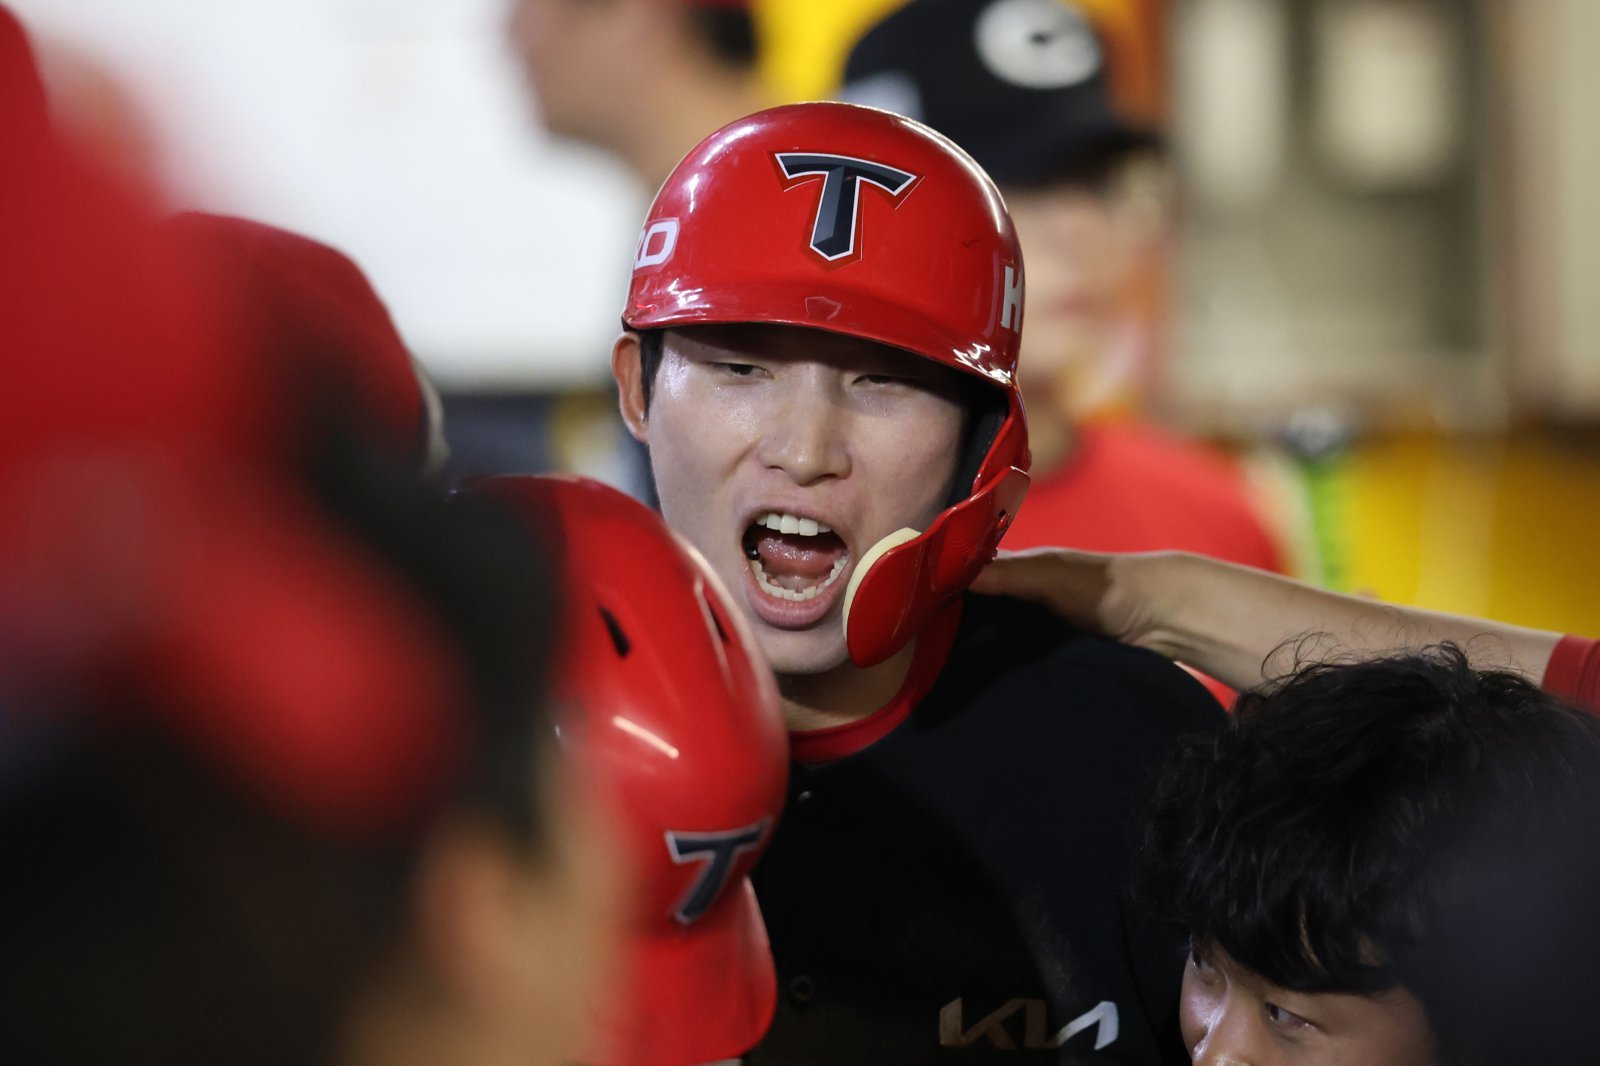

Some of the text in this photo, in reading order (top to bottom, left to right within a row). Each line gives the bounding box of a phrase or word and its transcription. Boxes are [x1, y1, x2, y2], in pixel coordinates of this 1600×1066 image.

[774, 152, 918, 261] T
[663, 816, 772, 924] T
[938, 996, 1119, 1050] KIA
